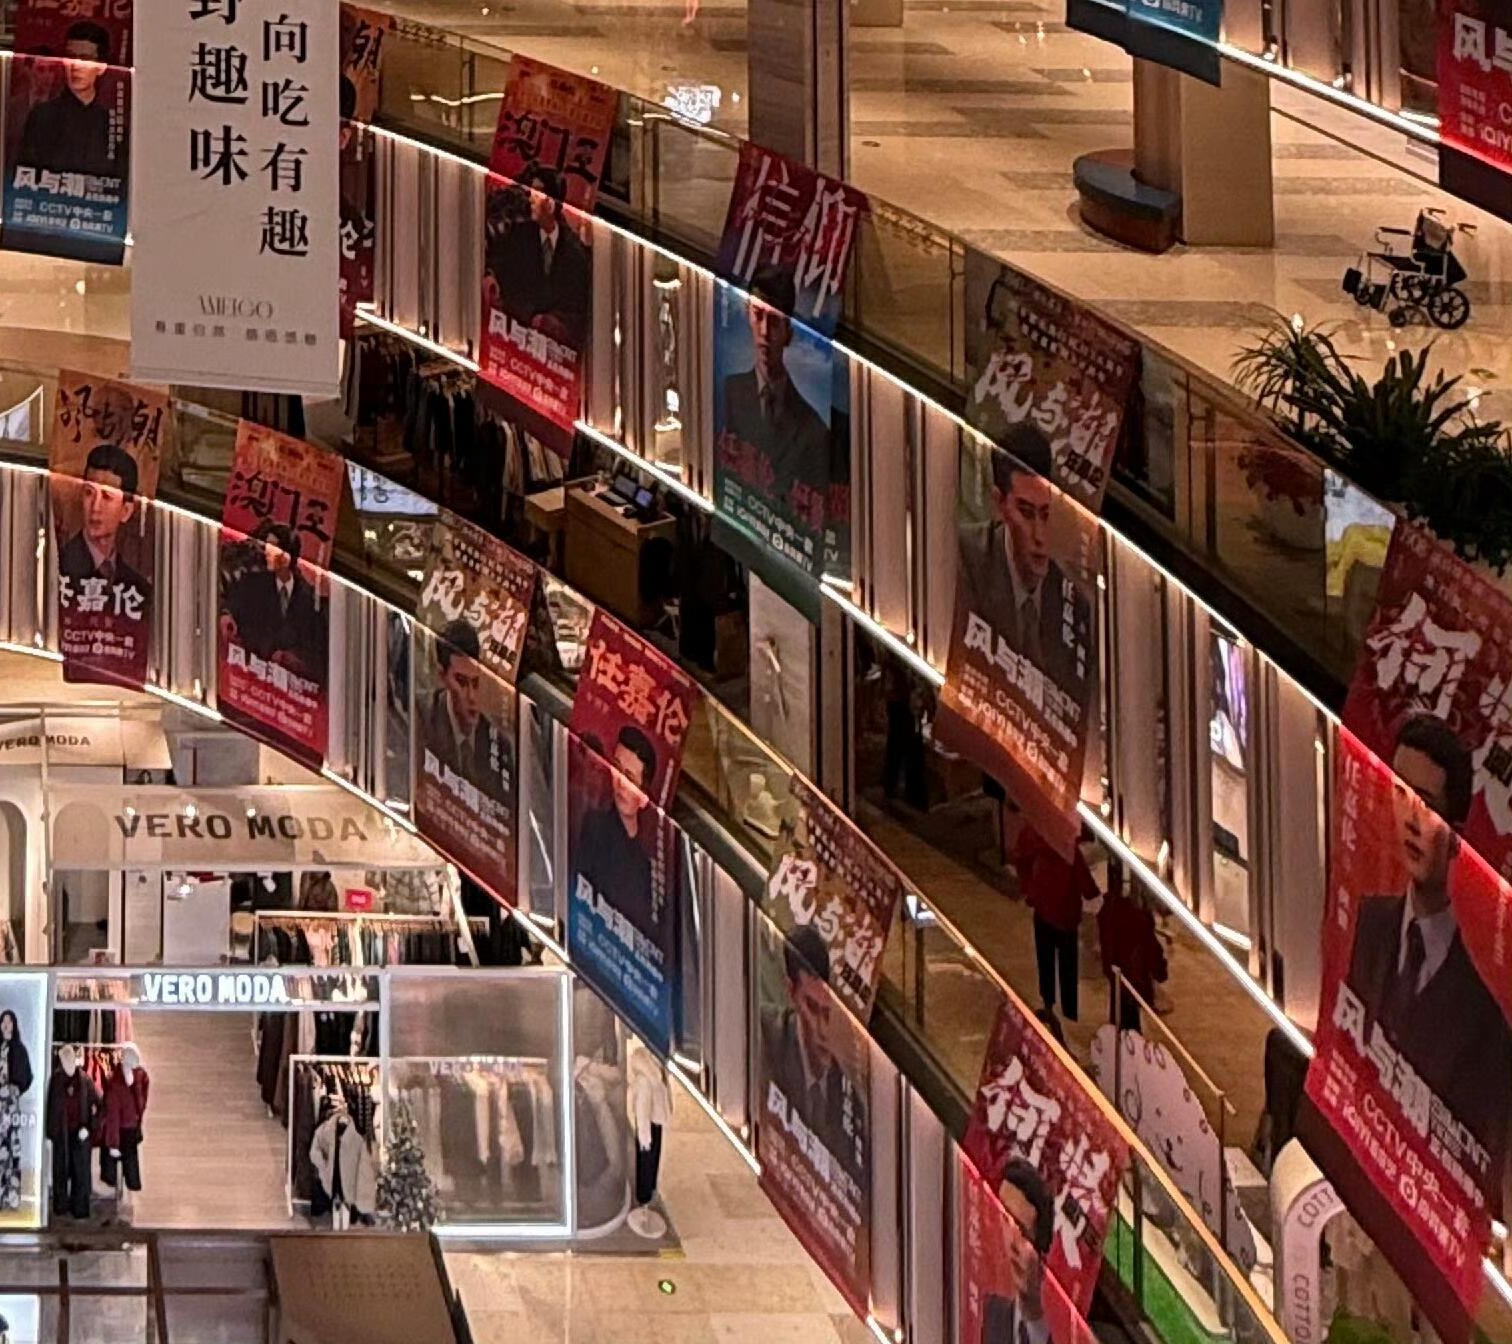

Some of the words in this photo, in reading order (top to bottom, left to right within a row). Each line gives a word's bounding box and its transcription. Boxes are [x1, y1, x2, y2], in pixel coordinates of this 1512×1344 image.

[589, 639, 689, 745] 任嘉伦
[44, 733, 91, 748] MODA
[115, 812, 232, 842] VERO
[247, 812, 368, 842] MODA
[144, 973, 212, 1004] VERO
[217, 973, 287, 1003] MODA
